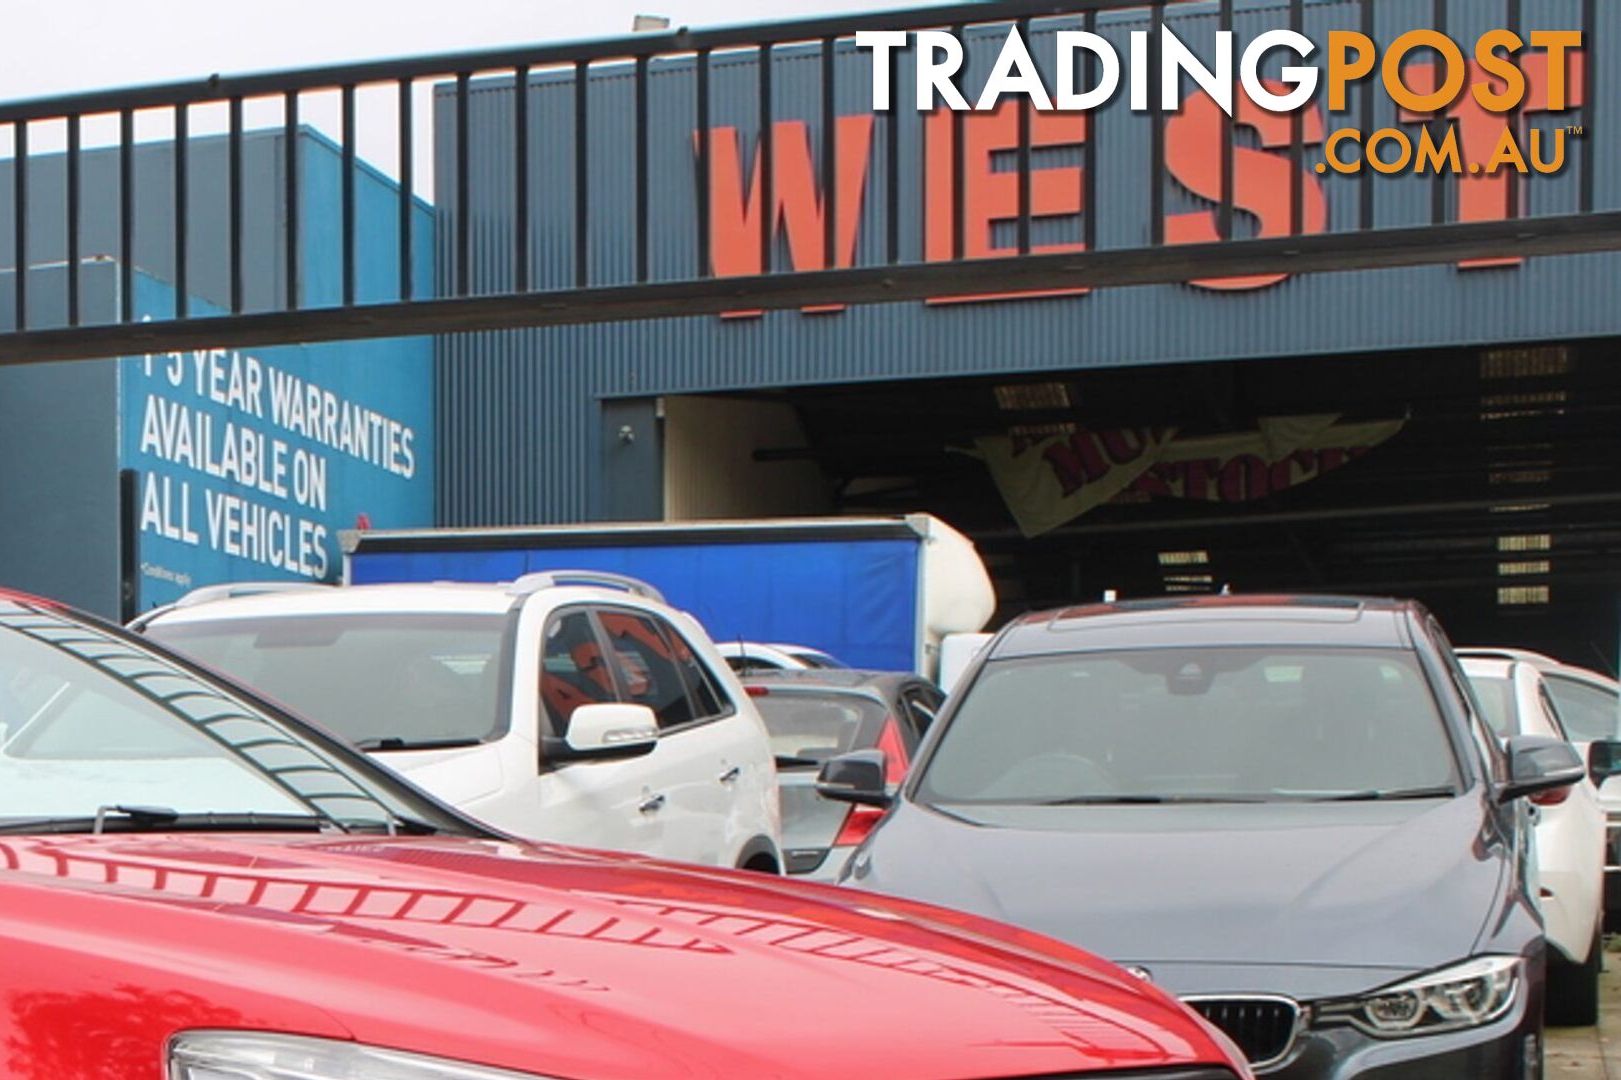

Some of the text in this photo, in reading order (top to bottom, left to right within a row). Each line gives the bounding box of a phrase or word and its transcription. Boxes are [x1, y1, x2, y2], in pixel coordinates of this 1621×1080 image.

[140, 394, 327, 513] AVAILABLE ON
[192, 347, 263, 419] YEAR
[268, 366, 416, 480] WARRANTIES
[140, 470, 329, 580] ALL VEHICLES
